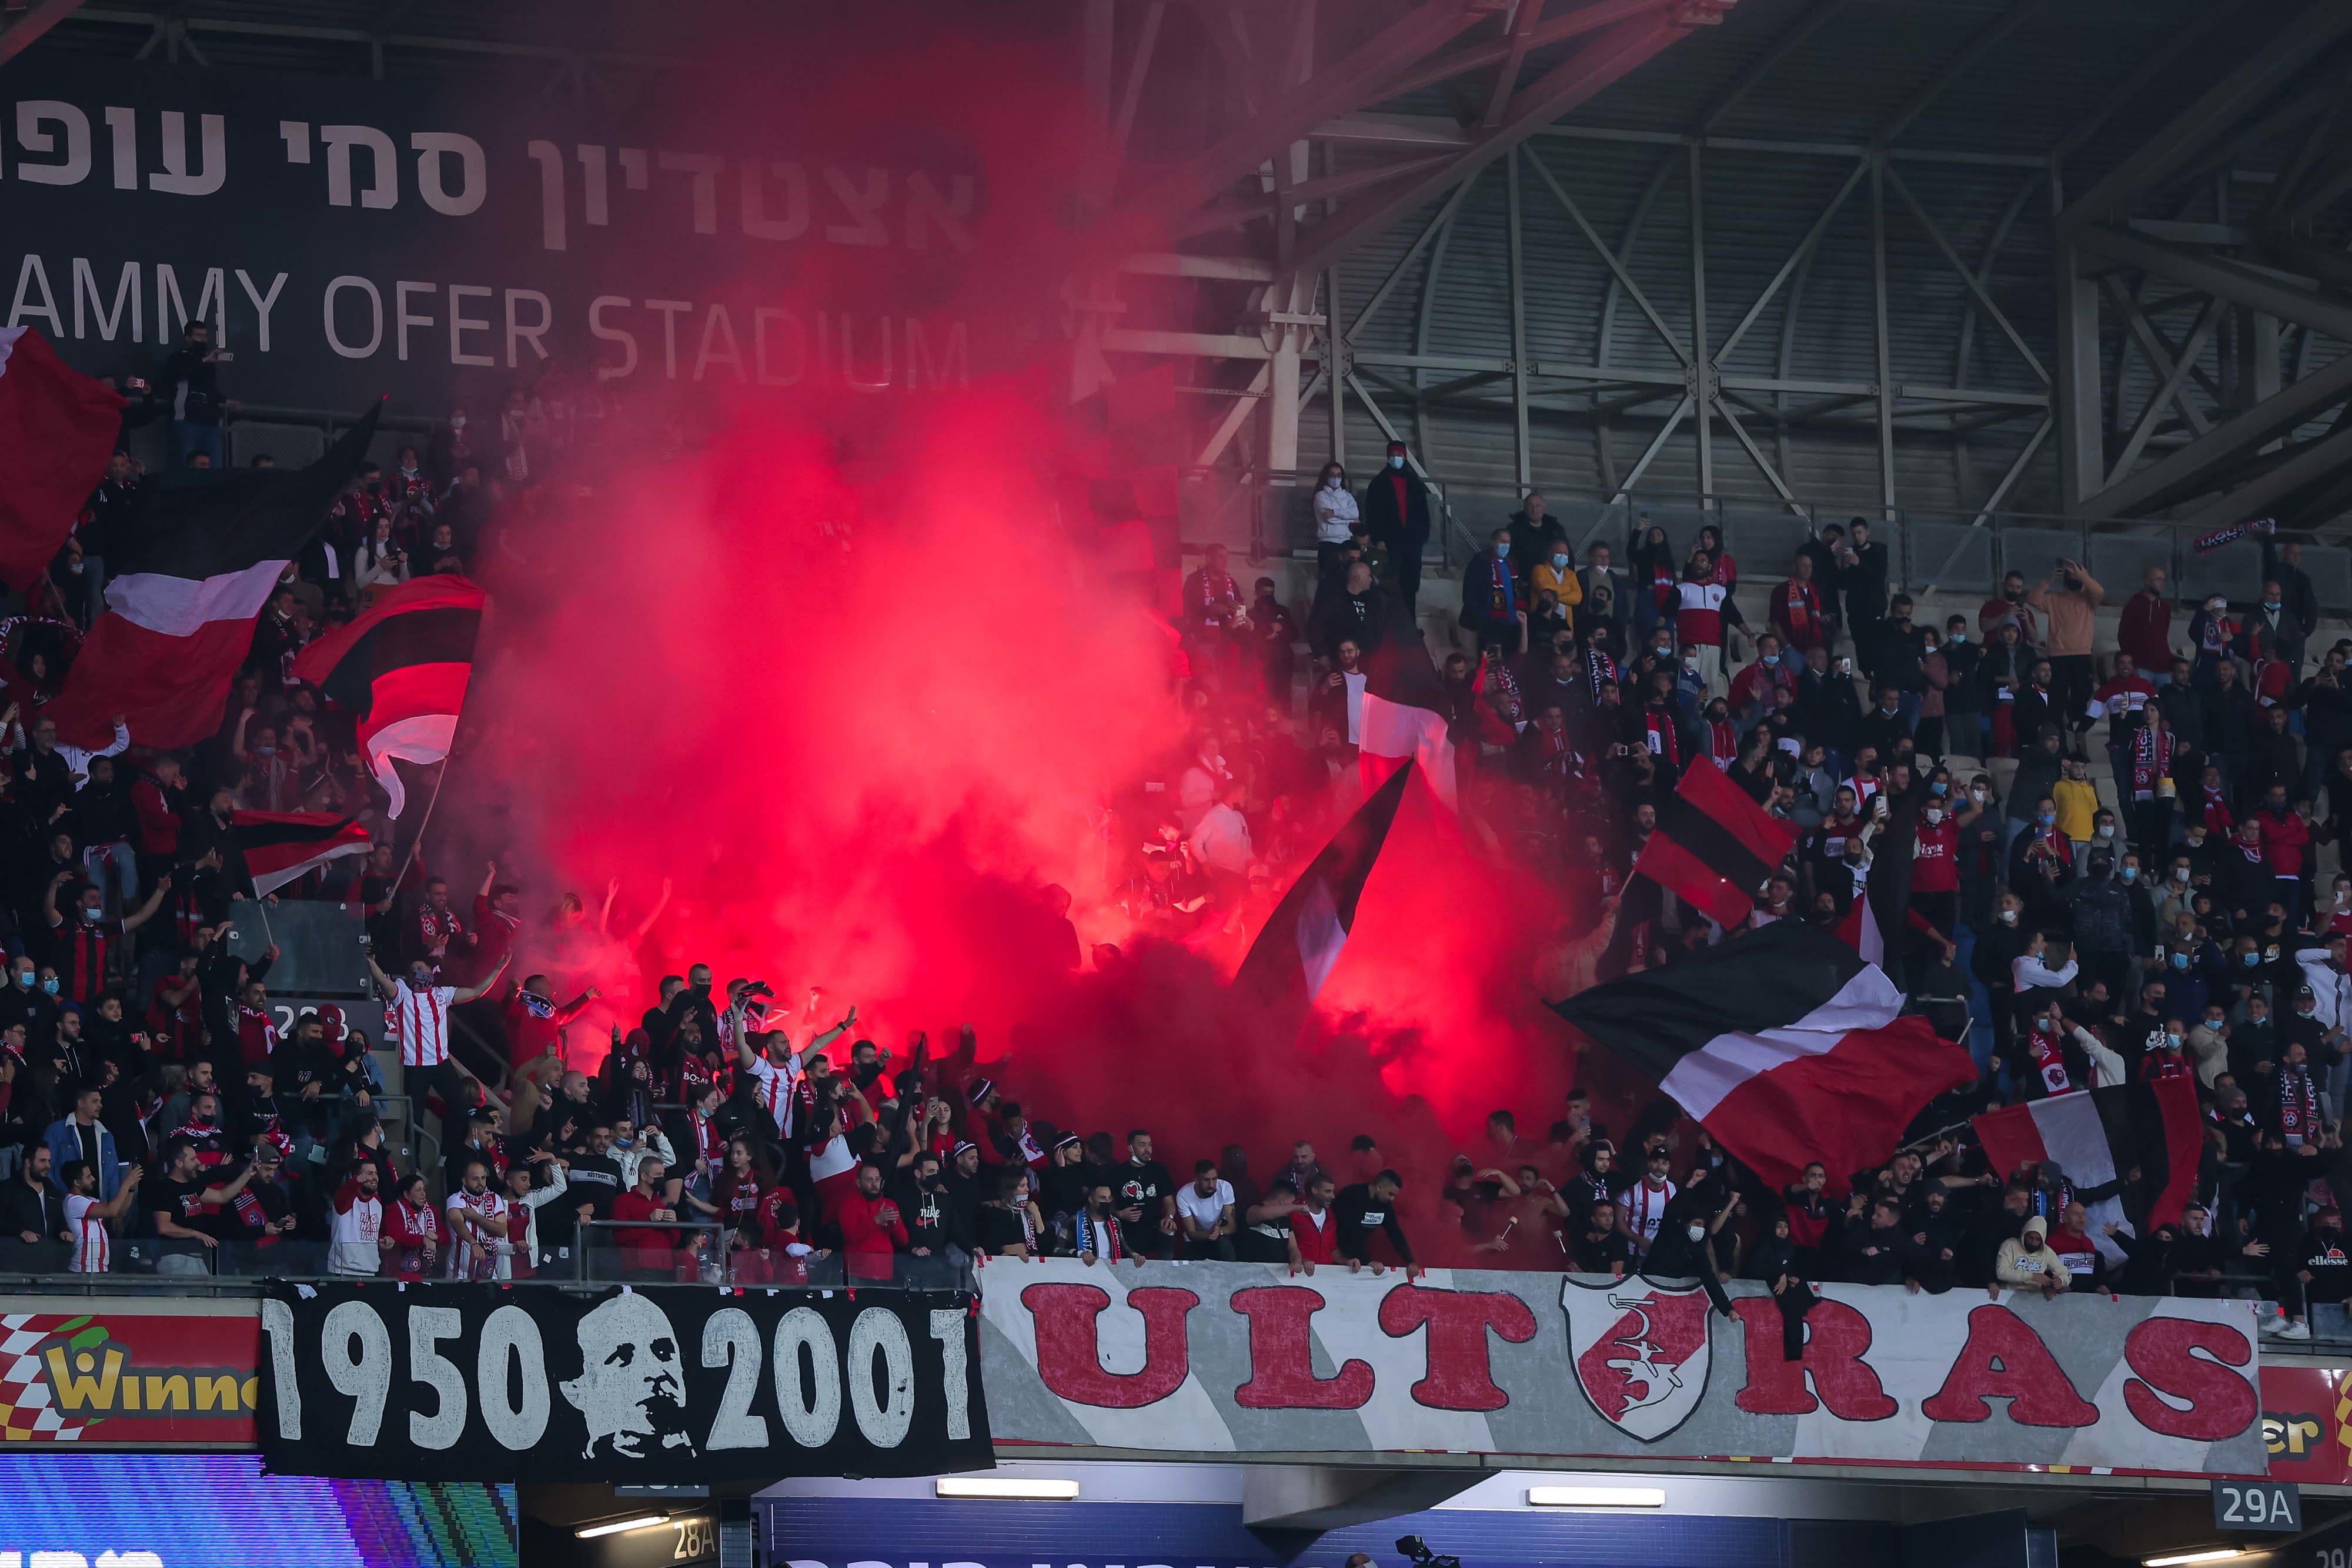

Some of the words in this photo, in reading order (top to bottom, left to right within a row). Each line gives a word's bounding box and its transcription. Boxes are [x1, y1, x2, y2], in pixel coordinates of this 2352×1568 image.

[0, 100, 227, 196] עופ
[280, 120, 487, 216] סמי
[528, 140, 976, 255] אצטדיון
[323, 275, 551, 368] OFER
[589, 295, 970, 394] STADIUM
[920, 1205, 940, 1218] nike
[2308, 1255, 2348, 1265] ellesse
[262, 1298, 551, 1451] 1950
[702, 1307, 971, 1449] 2001
[673, 1517, 716, 1560] 28A
[2222, 1487, 2294, 1524] 29A
